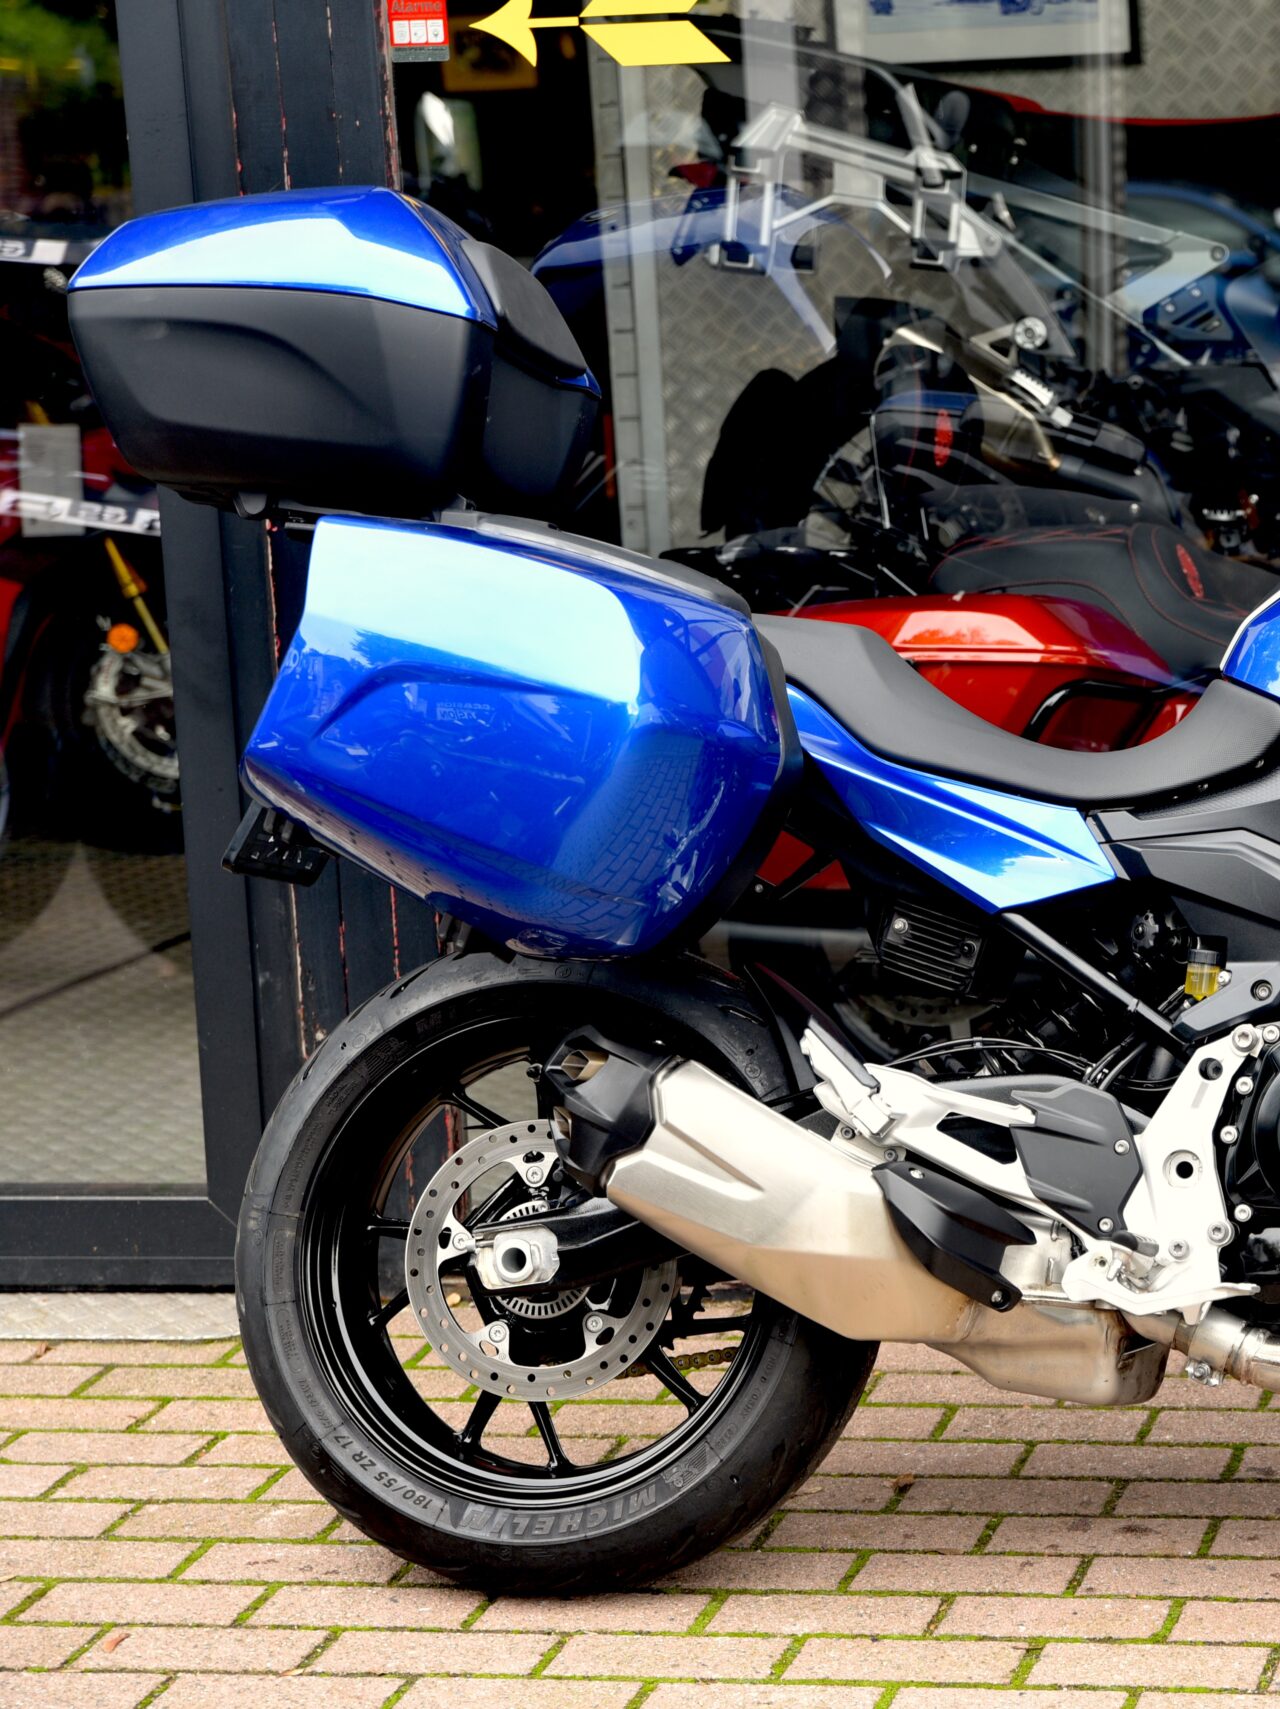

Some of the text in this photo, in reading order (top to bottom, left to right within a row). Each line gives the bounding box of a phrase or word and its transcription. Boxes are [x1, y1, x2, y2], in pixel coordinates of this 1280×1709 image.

[333, 1434, 355, 1450] 17
[351, 1450, 377, 1472] ZR
[372, 1471, 434, 1511] 180/55
[460, 1483, 658, 1537] MICHELIN
